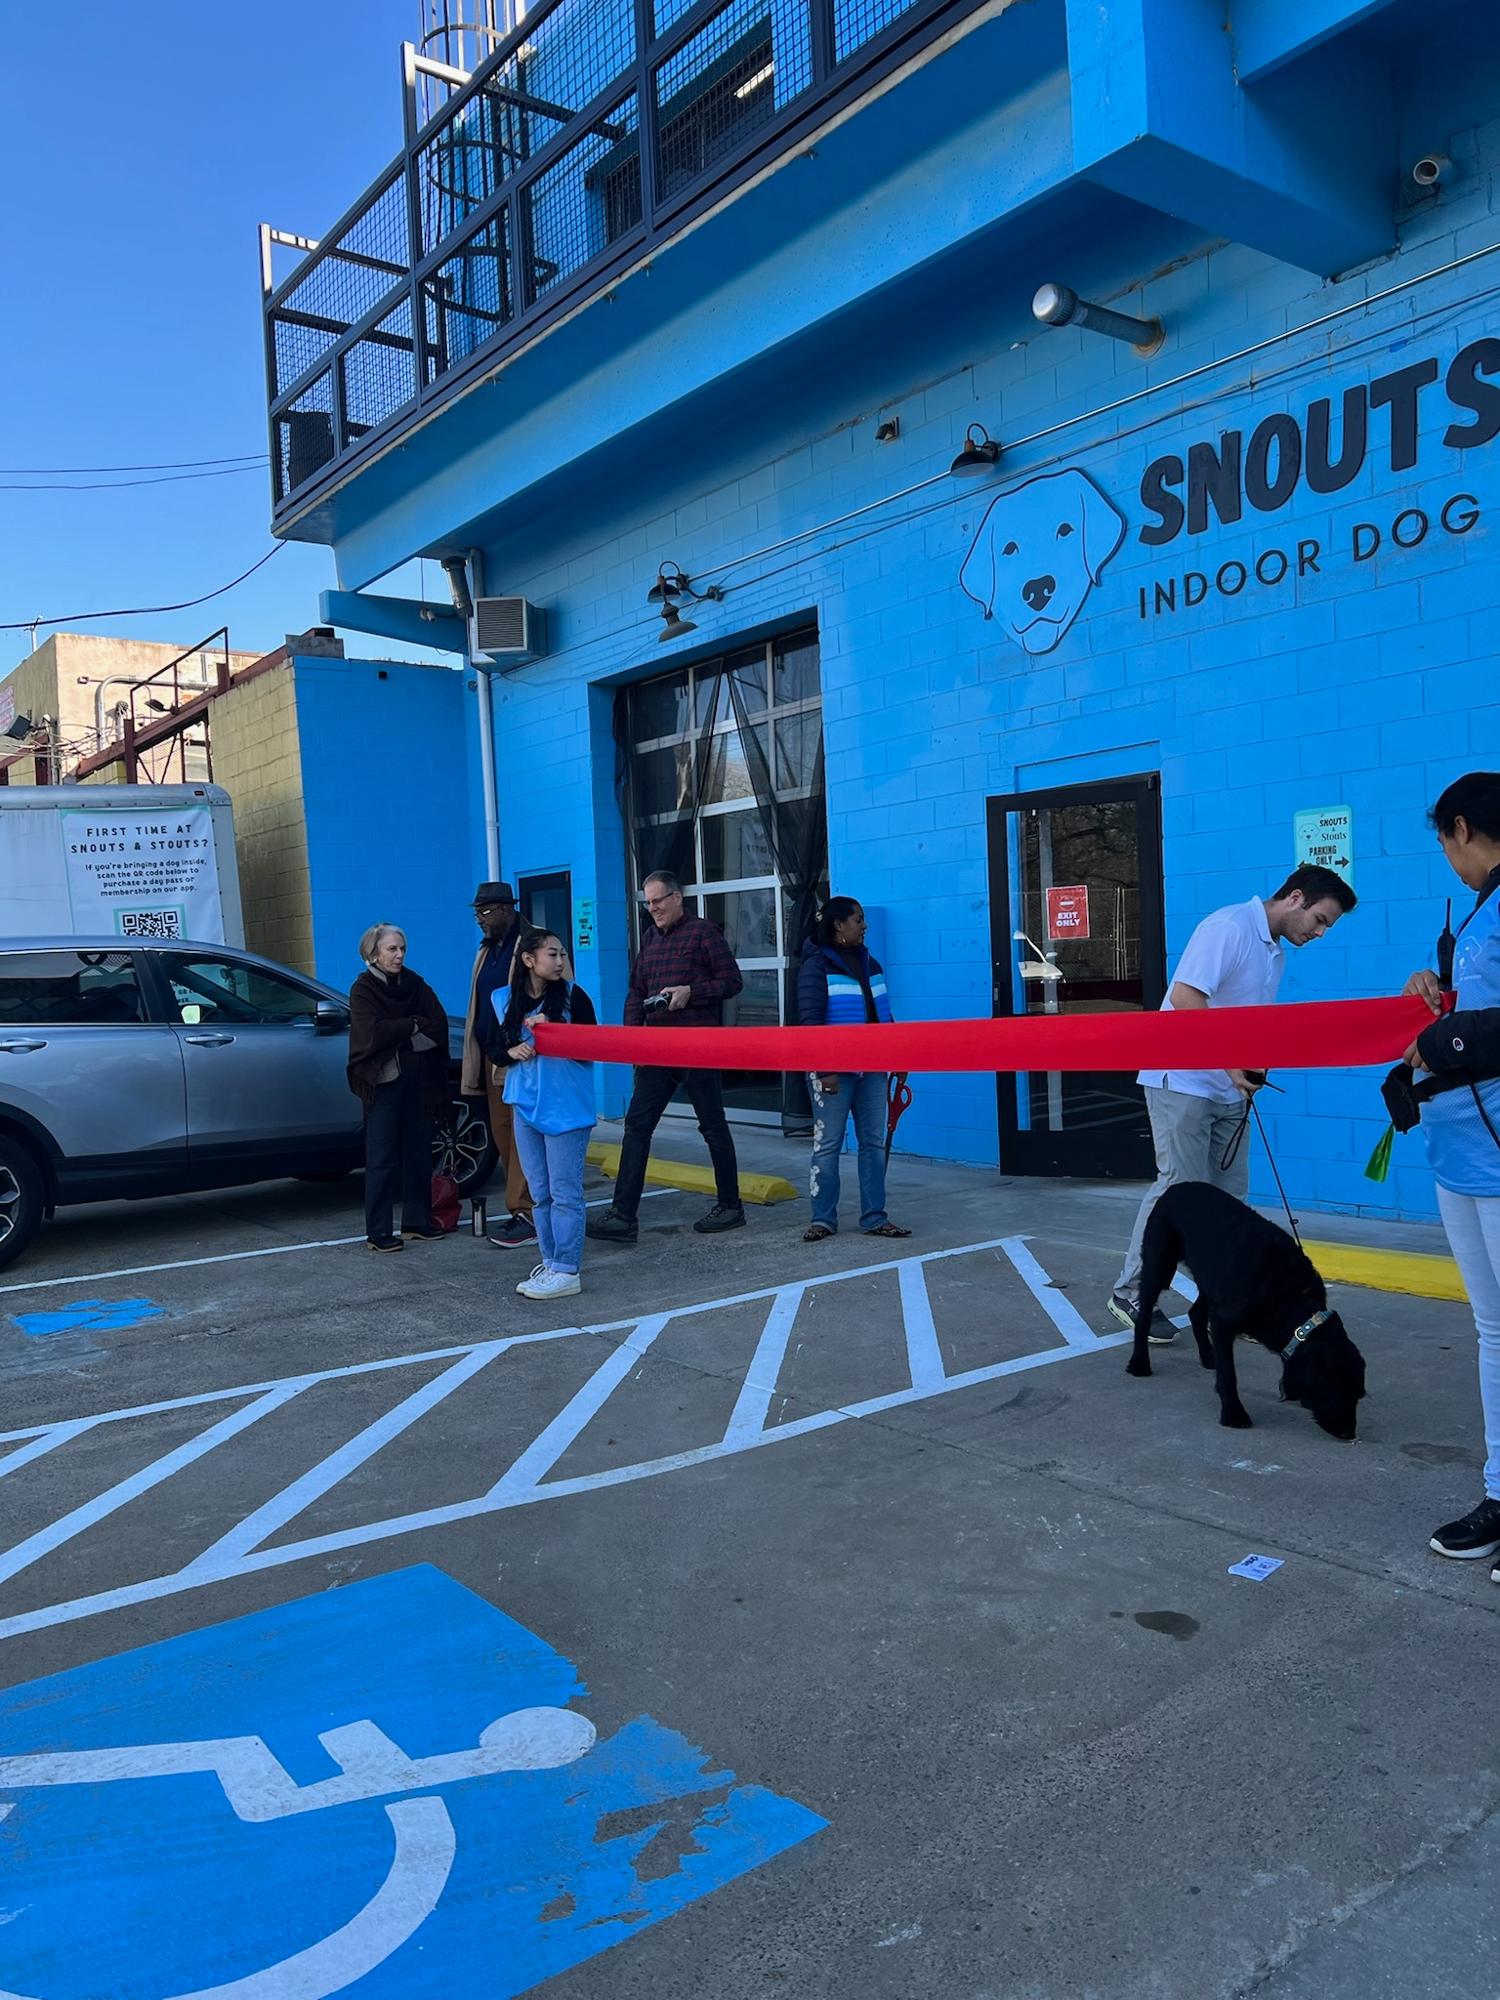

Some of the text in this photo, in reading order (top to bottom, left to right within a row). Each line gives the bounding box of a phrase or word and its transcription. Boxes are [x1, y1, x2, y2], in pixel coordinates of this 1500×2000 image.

[1139, 338, 1500, 546] SNOUTS
[1139, 493, 1480, 618] INDOOR DOG
[1319, 817, 1347, 827] SNOUTS
[87, 824, 192, 837] FIRST TIME AT
[1321, 832, 1347, 841] Stouts
[71, 839, 208, 854] SNOUTS & STOUTS?
[1309, 845, 1337, 856] PARKING
[85, 863, 92, 871] If
[94, 862, 122, 872] you're
[123, 861, 158, 870] bringing
[166, 859, 180, 868] dog
[181, 857, 207, 866] inside,
[1316, 856, 1333, 865] ONLY
[145, 869, 164, 877] code
[103, 880, 140, 889] purchase
[149, 878, 164, 886] day
[165, 877, 183, 885] pass
[100, 887, 151, 897] membership
[1056, 919, 1080, 927] ONLY
